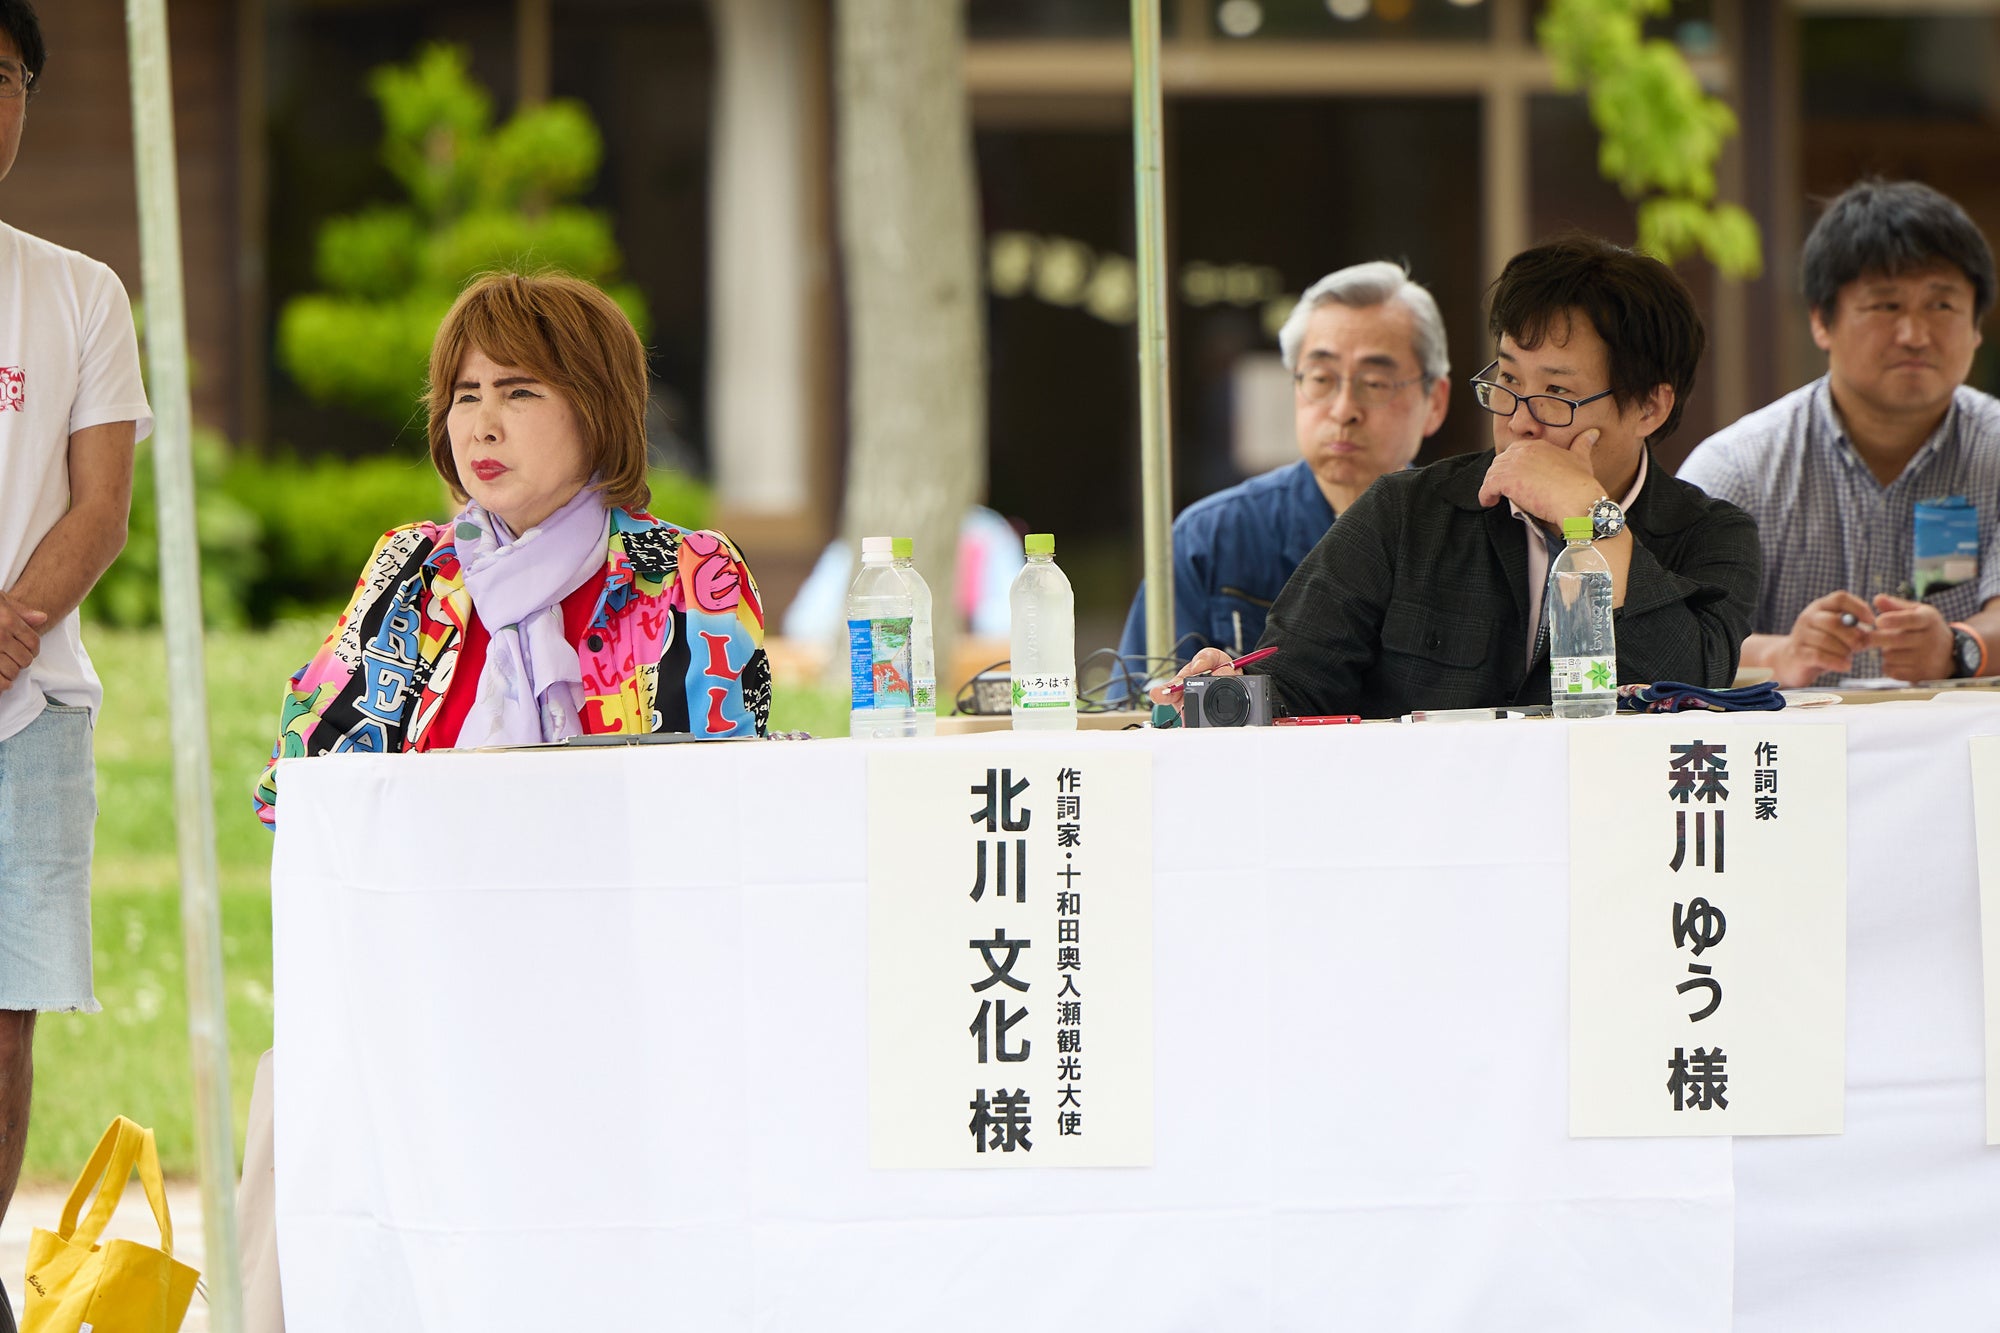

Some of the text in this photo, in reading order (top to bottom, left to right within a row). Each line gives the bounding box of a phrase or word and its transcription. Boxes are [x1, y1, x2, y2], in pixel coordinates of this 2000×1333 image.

[968, 768, 1033, 1153] 北川 文化 様
[1056, 767, 1082, 1136] 作詞家・十和田奥入瀬観光大使
[1666, 739, 1730, 1112] 森川 ゆう 様
[1753, 741, 1778, 821] 作詞家
